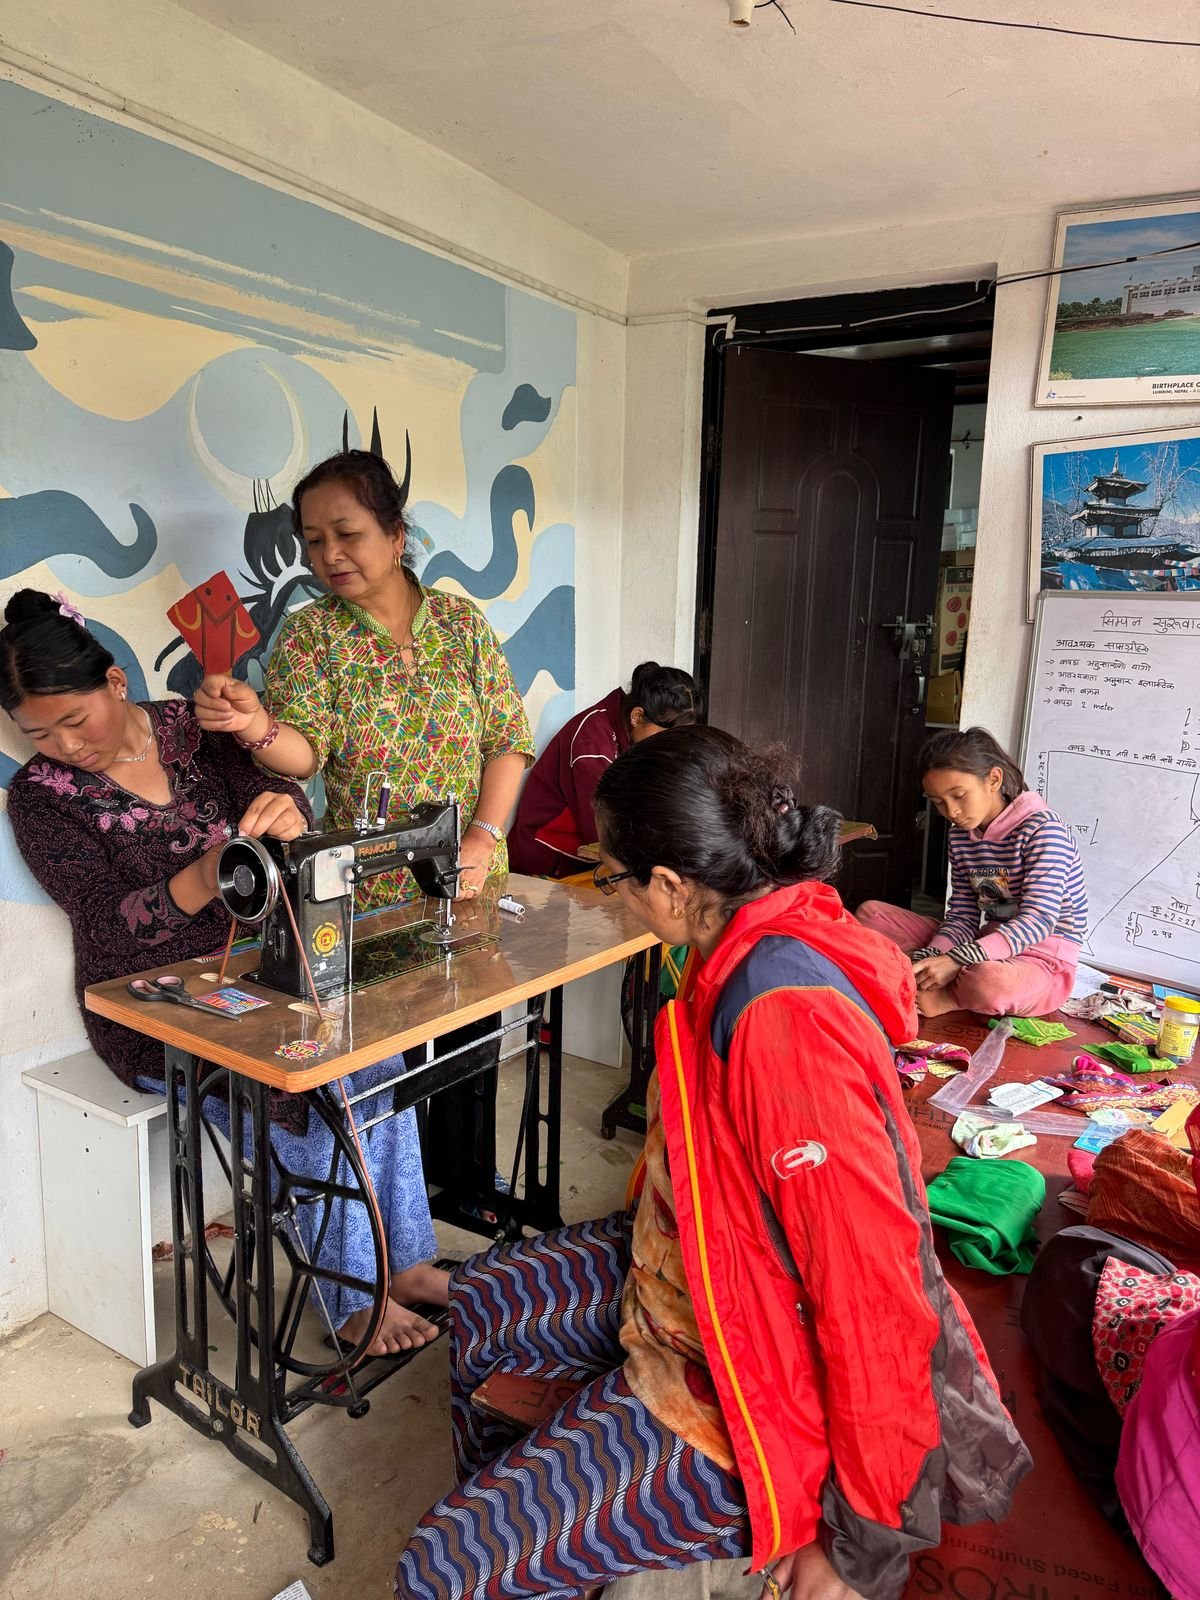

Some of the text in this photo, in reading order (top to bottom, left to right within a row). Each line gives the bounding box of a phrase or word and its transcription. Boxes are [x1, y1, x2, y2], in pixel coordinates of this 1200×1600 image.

[1093, 702, 1114, 711] meter
[358, 840, 397, 857] FAMOUS
[179, 1362, 261, 1439] TAILOR
[1054, 1564, 1121, 1594] Faced
